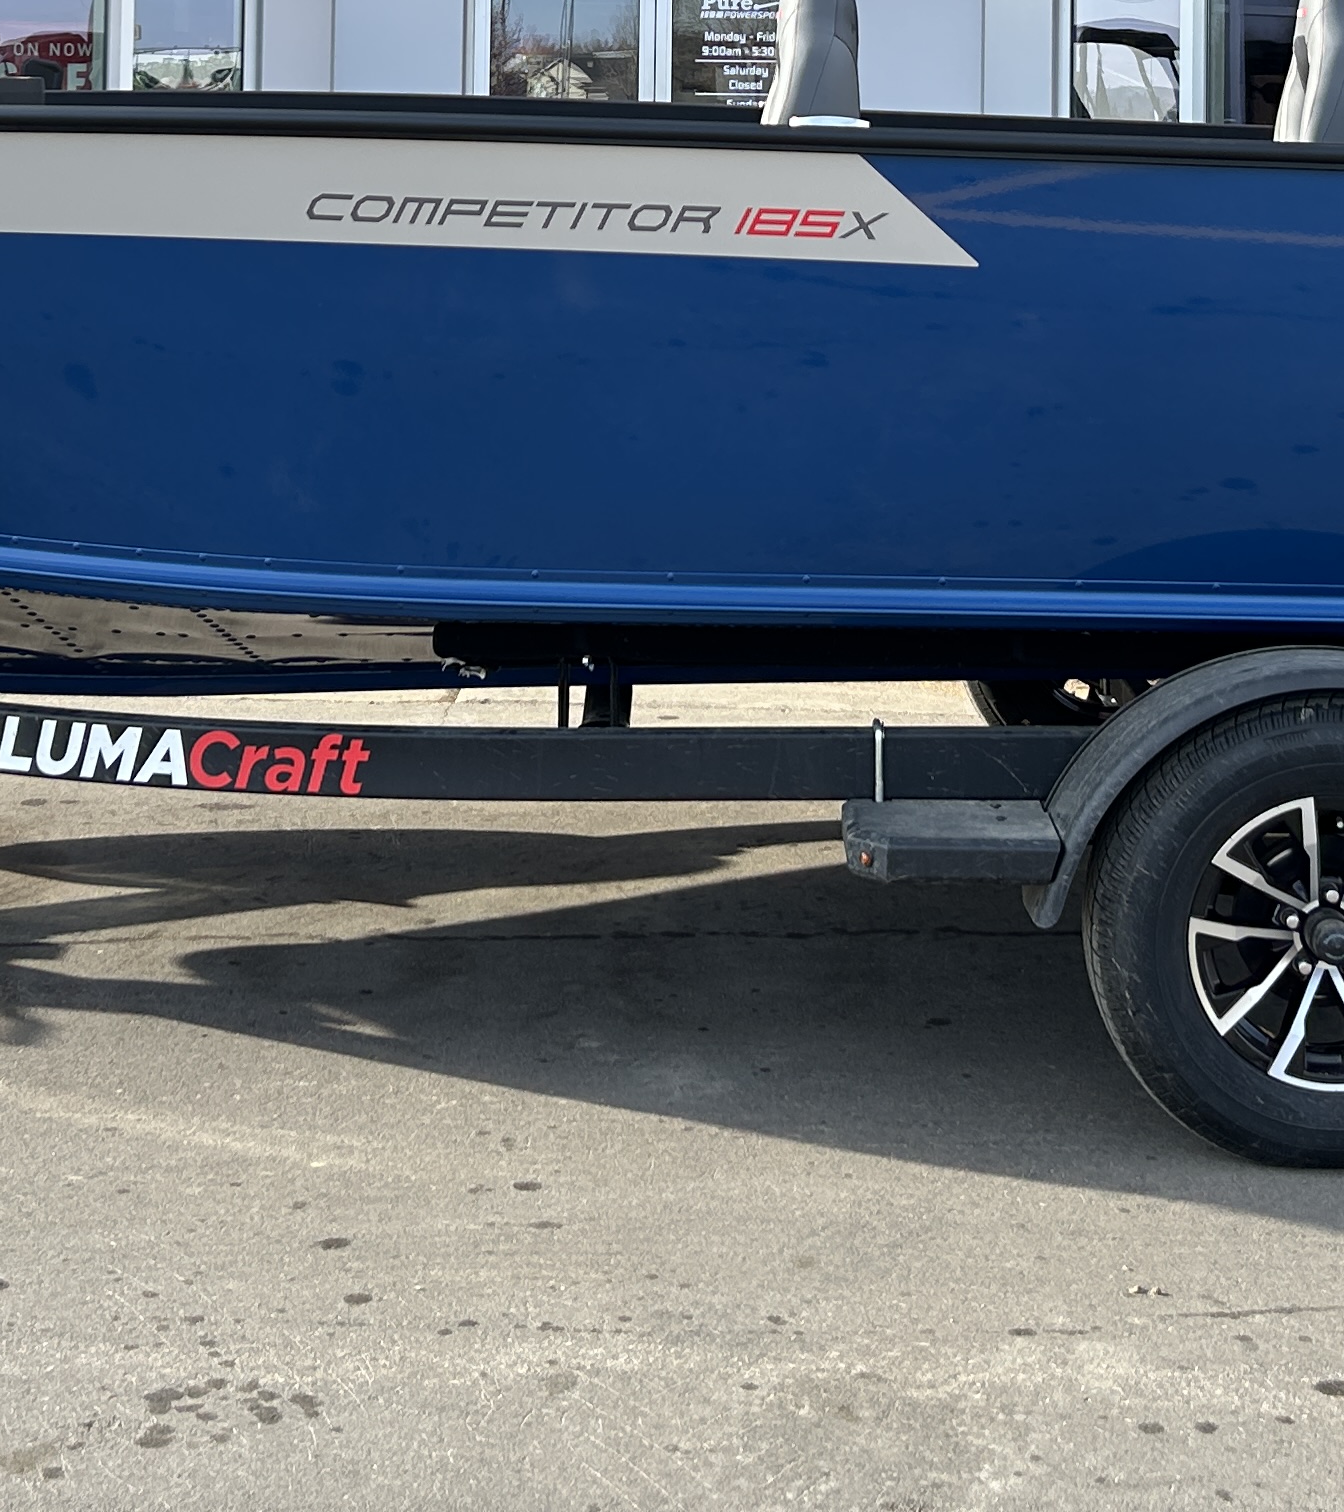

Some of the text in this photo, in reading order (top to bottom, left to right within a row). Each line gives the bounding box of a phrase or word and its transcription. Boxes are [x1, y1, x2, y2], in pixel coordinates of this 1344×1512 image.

[723, 10, 776, 19] POWERSPO
[704, 31, 747, 44] Monday
[756, 31, 776, 42] Frid
[13, 42, 94, 57] ON NOW
[701, 45, 742, 56] 9:00am
[751, 46, 775, 56] 5:30
[723, 65, 769, 77] Saturday
[728, 80, 763, 90] Closed
[306, 192, 721, 234] COMPETITOR
